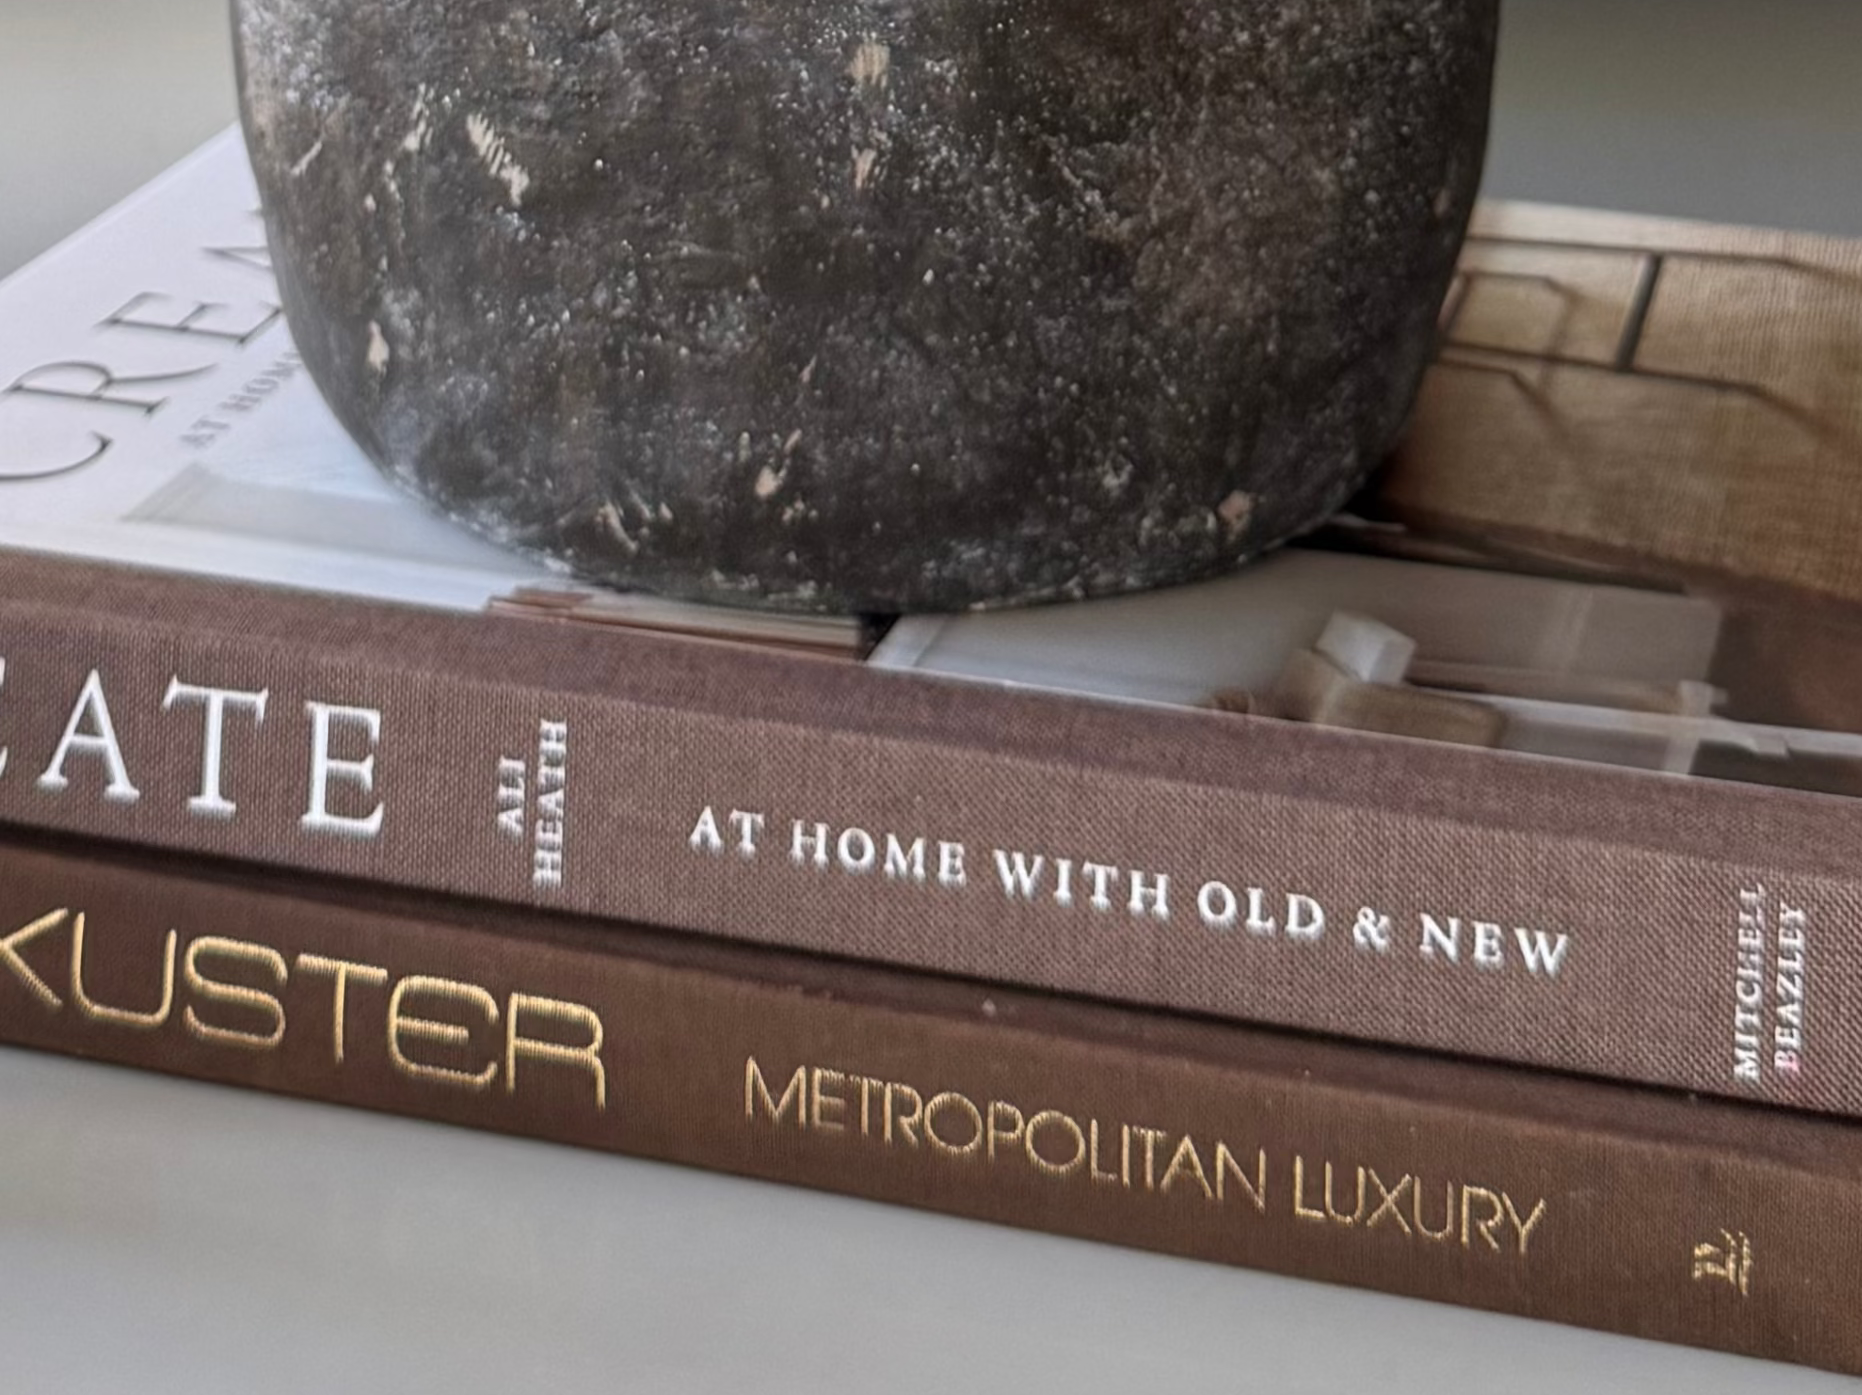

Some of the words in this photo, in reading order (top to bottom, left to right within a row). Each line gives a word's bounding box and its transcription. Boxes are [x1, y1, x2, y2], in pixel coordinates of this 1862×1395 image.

[0, 658, 384, 838] ATE
[498, 757, 526, 840] ALI
[532, 719, 568, 890] HEATH
[689, 806, 765, 858] AT
[790, 818, 967, 887] HOME
[993, 849, 1171, 920] WITH
[1198, 880, 1326, 941] OLD
[1352, 907, 1390, 952] &
[1419, 913, 1570, 977] NEW
[1734, 882, 1766, 1083] MITCHELL
[1774, 902, 1806, 1075] BEAZLEY
[744, 1055, 1266, 1214] METROPOLITAN
[1293, 1155, 1547, 1256] LUXURY
